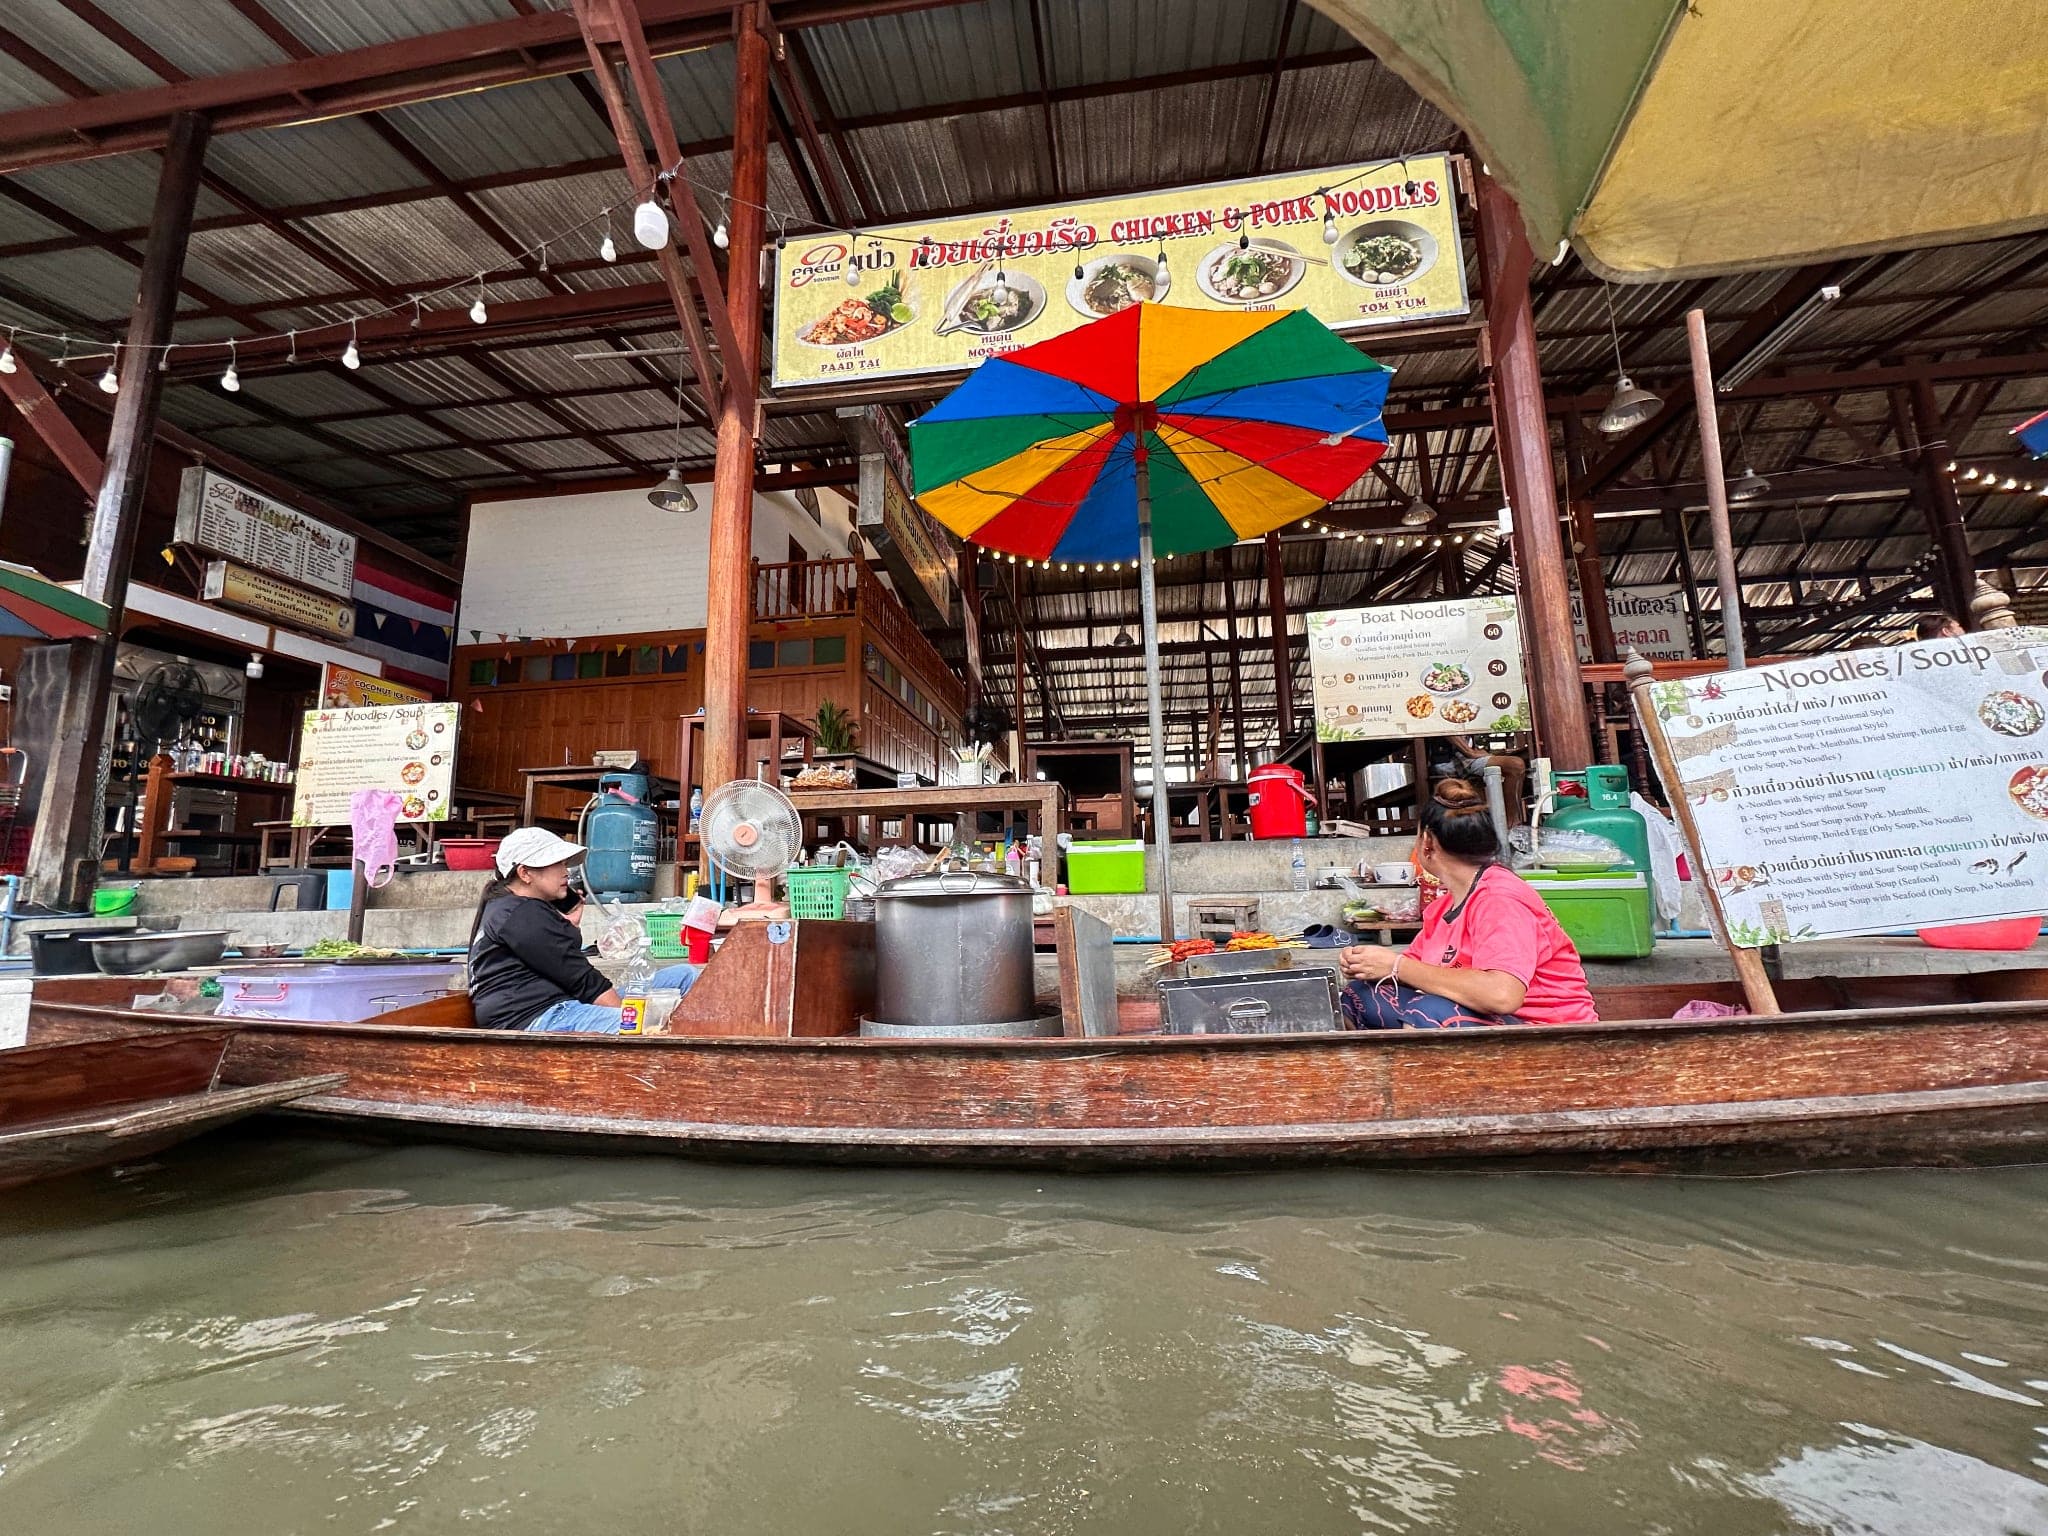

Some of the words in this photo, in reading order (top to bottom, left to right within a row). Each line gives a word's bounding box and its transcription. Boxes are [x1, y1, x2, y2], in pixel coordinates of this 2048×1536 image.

[1110, 209, 1213, 244] CHICKEN
[1223, 207, 1242, 230] &
[1250, 196, 1319, 227] PORK
[1323, 181, 1438, 215] NOODLES
[1359, 302, 1389, 313] TOM
[1396, 297, 1427, 309] YUM
[968, 346, 997, 358] MOO
[820, 361, 854, 373] PAAD
[859, 358, 880, 369] TAI
[1360, 611, 1397, 625] Boat
[1400, 604, 1466, 621] Noodles
[1487, 627, 1500, 636] 60
[1491, 663, 1504, 672] 50
[1760, 656, 1889, 692] Noodles
[1897, 651, 1903, 676] /
[1910, 644, 1992, 671] Soup
[354, 680, 392, 695] COCONUT
[405, 695, 426, 703] CREA
[1495, 696, 1508, 705] 40
[344, 709, 388, 721] Noodles
[395, 708, 424, 721] Soup
[1726, 727, 1758, 737] Noodles
[1759, 724, 1777, 733] with
[1777, 721, 1799, 730] Clear
[1801, 717, 1822, 727] Soup
[1822, 710, 1869, 724] (Traditional
[1870, 707, 1895, 717] Style)
[1719, 755, 1727, 763] C
[1733, 752, 1755, 761] Clear
[1756, 748, 1777, 759] Soup
[1778, 746, 1796, 754] with
[1797, 741, 1820, 751] Pork,
[1820, 738, 1862, 749] Meatballs,
[1862, 733, 1886, 743] Dried
[1886, 729, 1920, 741] Shrimp,
[1920, 725, 1947, 736] Boiled
[1948, 723, 1966, 734] Egg
[1730, 739, 1762, 749] Noodles
[1763, 734, 1793, 745] without
[1794, 729, 1815, 740] Soup
[1815, 724, 1863, 738] (Traditional
[1863, 721, 1888, 731] Style)
[1743, 763, 1763, 773] Only
[1765, 760, 1789, 770] Soup,
[1789, 758, 1802, 767] No
[1803, 754, 1836, 764] Noodles
[1736, 803, 1744, 811] A
[1783, 795, 1801, 804] with
[1803, 791, 1826, 803] Spicy
[1827, 790, 1843, 799] and
[1844, 788, 1863, 797] Sour
[1864, 785, 1887, 795] Soup
[1740, 815, 1748, 823] B
[1754, 811, 1778, 822] Spicy
[1779, 807, 1813, 818] Noodles
[1815, 803, 1846, 814] without
[1847, 800, 1868, 811] Soup
[1744, 827, 1752, 836] C
[1759, 823, 1782, 835] Spicy
[1784, 820, 1800, 830] and
[1800, 819, 1820, 829] Sour
[1821, 816, 1843, 827] Soup
[1844, 814, 1862, 823] with
[1763, 837, 1787, 847] Dried
[1787, 833, 1822, 845] Shrimp,
[1822, 829, 1850, 840] Boiled
[1850, 826, 1868, 837] Egg
[1869, 822, 1893, 835] (Only
[1895, 820, 1920, 831] Soup,
[1920, 818, 1934, 827] No
[1934, 814, 1973, 826] Noodles)
[1776, 876, 1812, 887] Noodles
[1813, 874, 1833, 882] with
[1833, 870, 1857, 882] Spicy
[1858, 868, 1874, 877] and
[1875, 866, 1895, 875] Sour
[1897, 862, 1919, 873] Soup
[1919, 857, 1961, 870] (Seafood)
[1781, 889, 1805, 901] Spicy
[1806, 886, 1841, 897] Noodles
[1842, 881, 1874, 892] without
[1874, 878, 1897, 889] Soup
[1898, 874, 1940, 887] (Seafood)
[1785, 904, 1810, 914] Spicy
[1811, 901, 1827, 910] and
[1828, 899, 1848, 909] Sour
[1849, 896, 1871, 907] Soup
[1871, 892, 1892, 902] with
[1893, 889, 1927, 901] Seafood
[1928, 887, 1952, 897] (Only
[1953, 884, 1980, 894] Soup,
[1981, 882, 1994, 891] No
[1995, 878, 2034, 889] Noodles)
